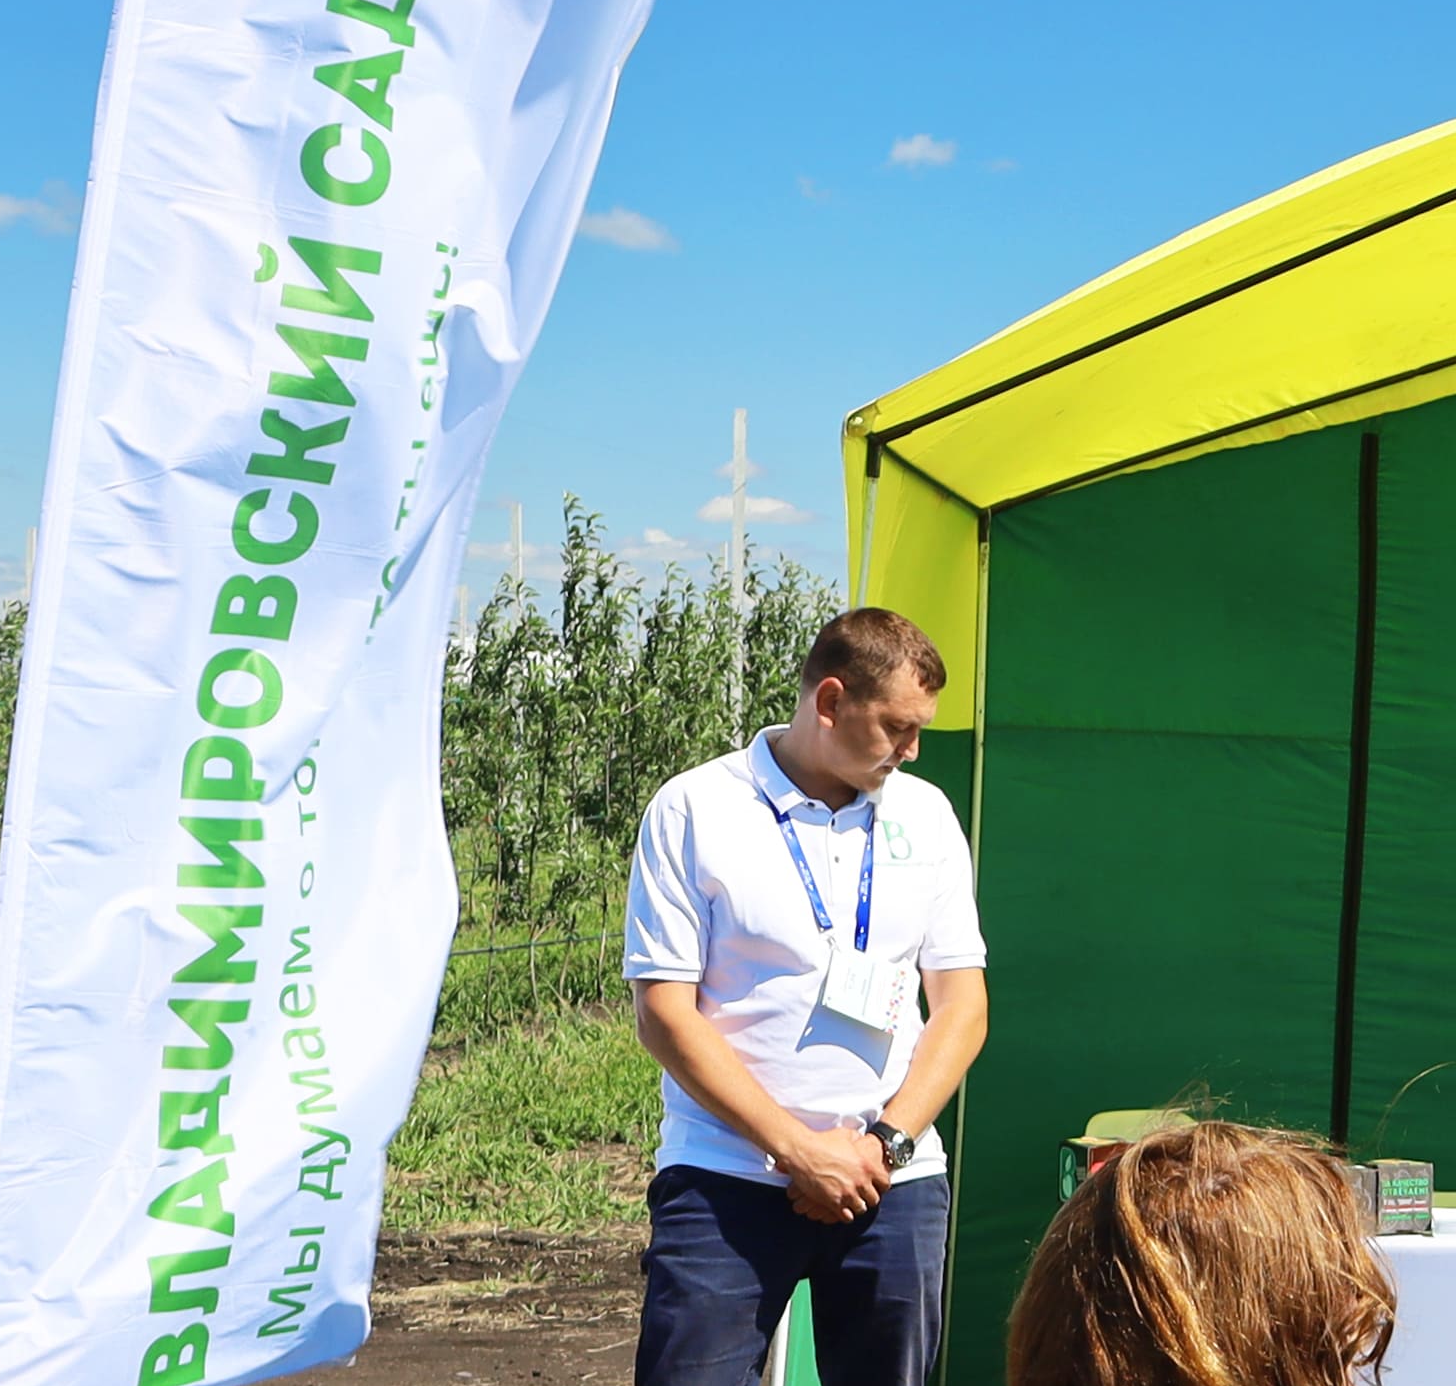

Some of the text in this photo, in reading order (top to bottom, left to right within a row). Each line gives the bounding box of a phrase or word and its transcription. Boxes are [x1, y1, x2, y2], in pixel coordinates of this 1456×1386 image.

[298, 860, 316, 898] о
[279, 925, 352, 1201] думаем
[258, 1226, 326, 1339] Мы
